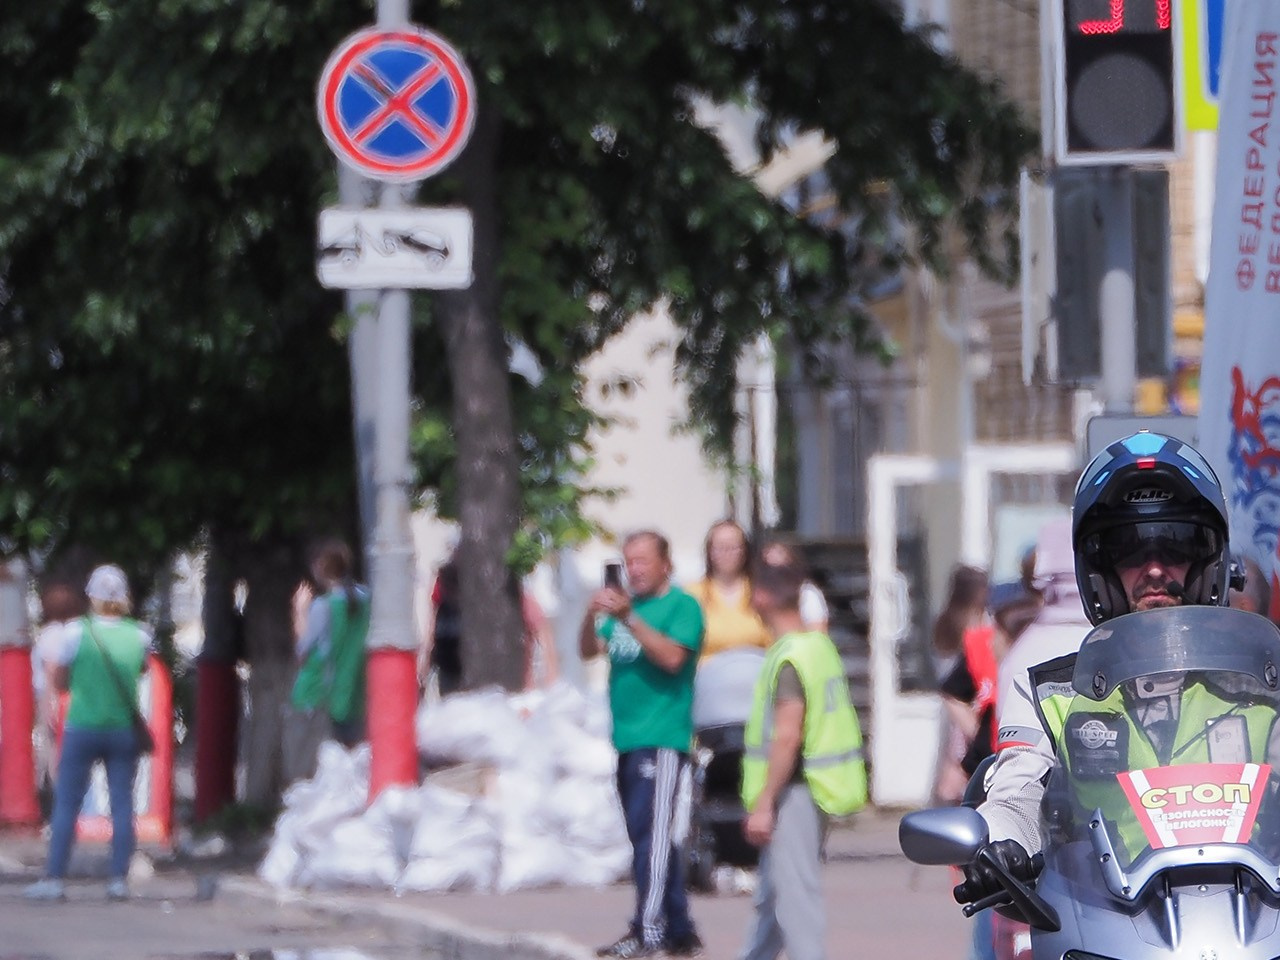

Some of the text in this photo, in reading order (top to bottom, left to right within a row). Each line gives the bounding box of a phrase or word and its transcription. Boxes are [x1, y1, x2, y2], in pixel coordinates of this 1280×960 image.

[1236, 31, 1278, 292] ФЕДЕРАЦИЯ
[1140, 782, 1252, 810] СТОП
[1152, 808, 1246, 823] БЕЗОПАСНОСТЬ
